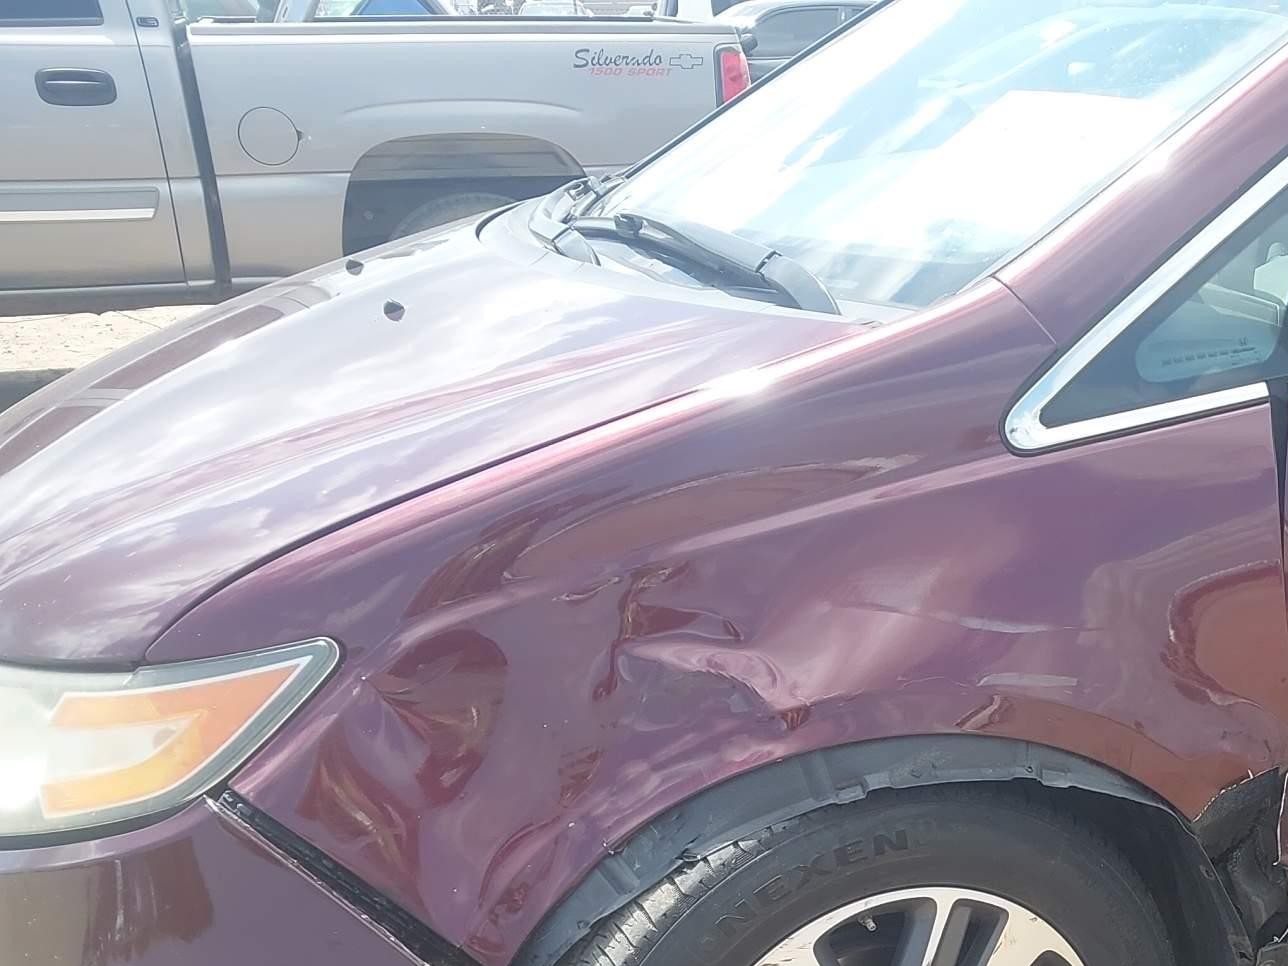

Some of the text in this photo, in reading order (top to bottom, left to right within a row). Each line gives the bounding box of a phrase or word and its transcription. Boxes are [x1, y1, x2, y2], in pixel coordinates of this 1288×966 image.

[590, 67, 673, 77] 1500 SPORT
[714, 829, 909, 937] NEXEN
